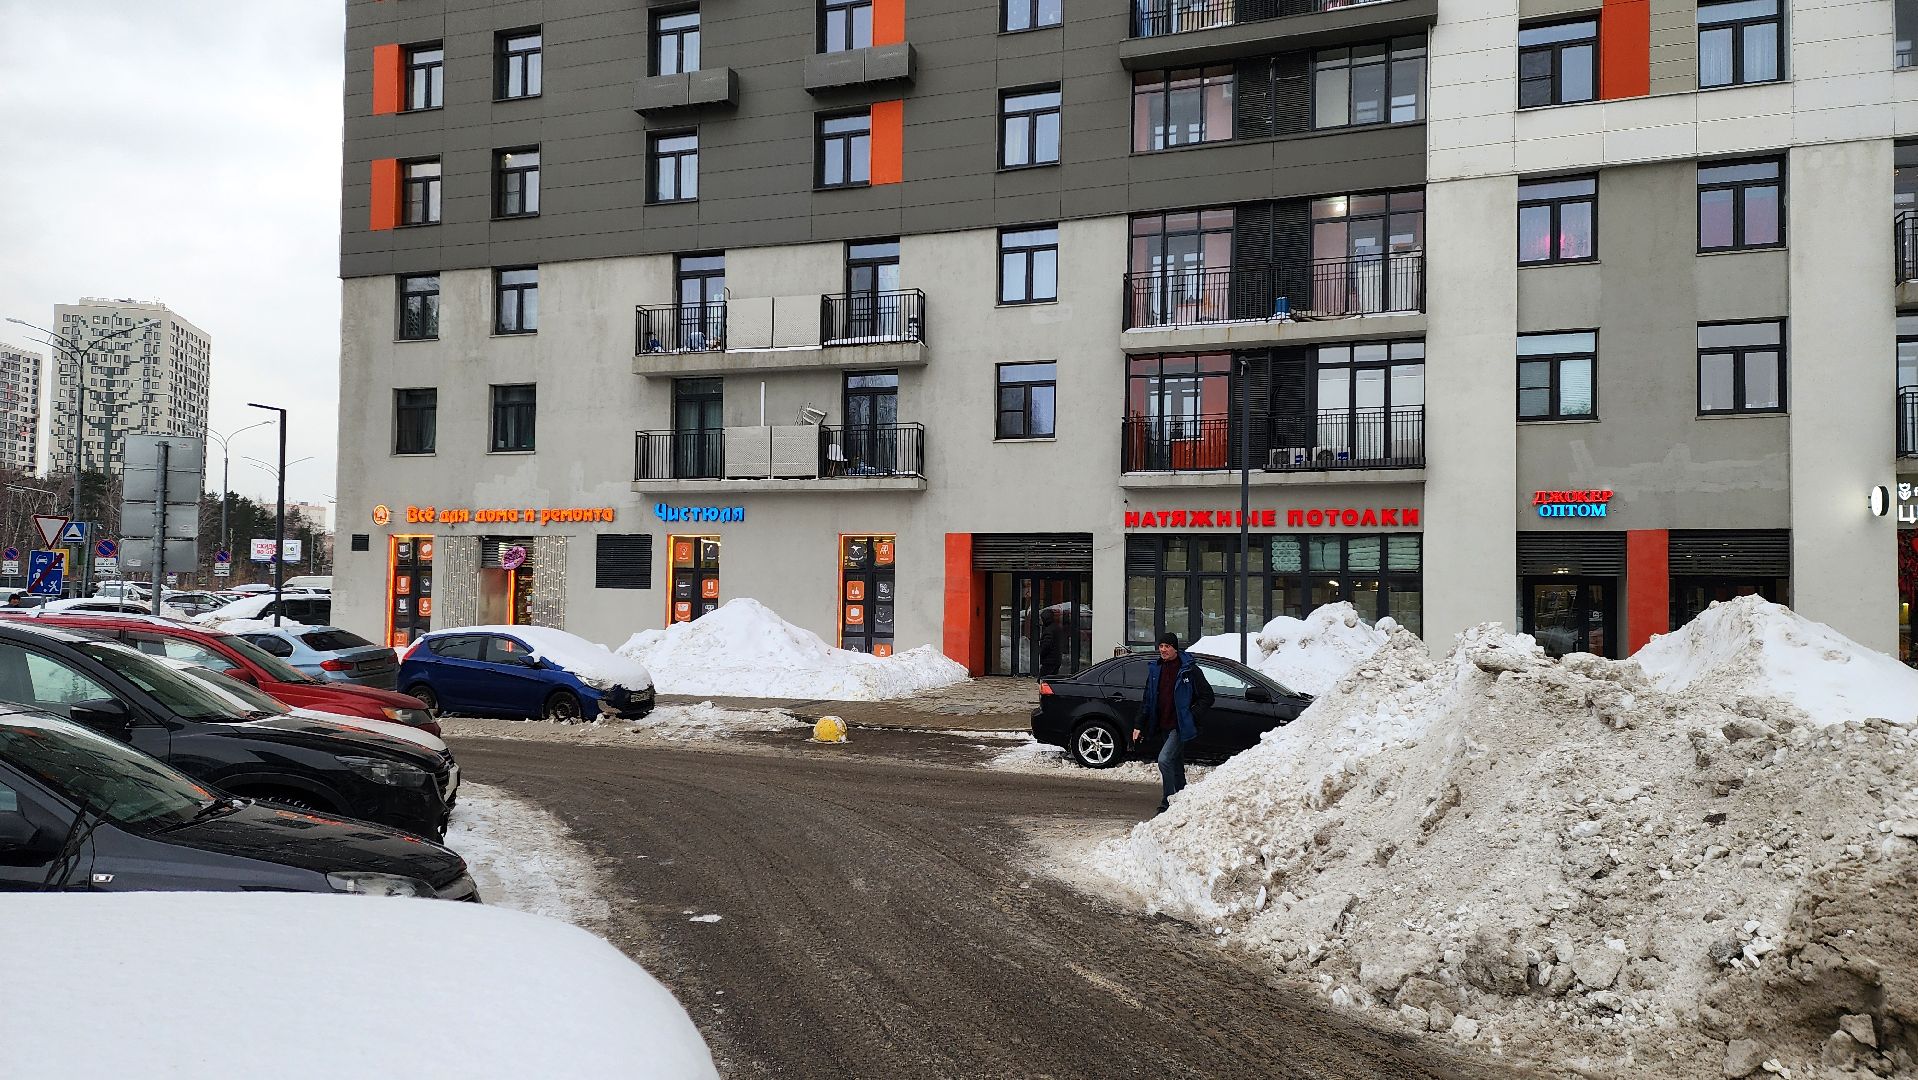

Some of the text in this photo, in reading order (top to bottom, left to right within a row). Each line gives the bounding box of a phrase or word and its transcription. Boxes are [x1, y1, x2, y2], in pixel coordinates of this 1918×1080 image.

[1533, 489, 1615, 506] ДЖОКЕР
[406, 505, 615, 526] Всё для дома и ремонта
[654, 502, 746, 523] Чистюля
[1124, 508, 1420, 528] НАТЯЖНЫЕ ПОТОЛКИ
[1538, 503, 1608, 518] ОПТОМ
